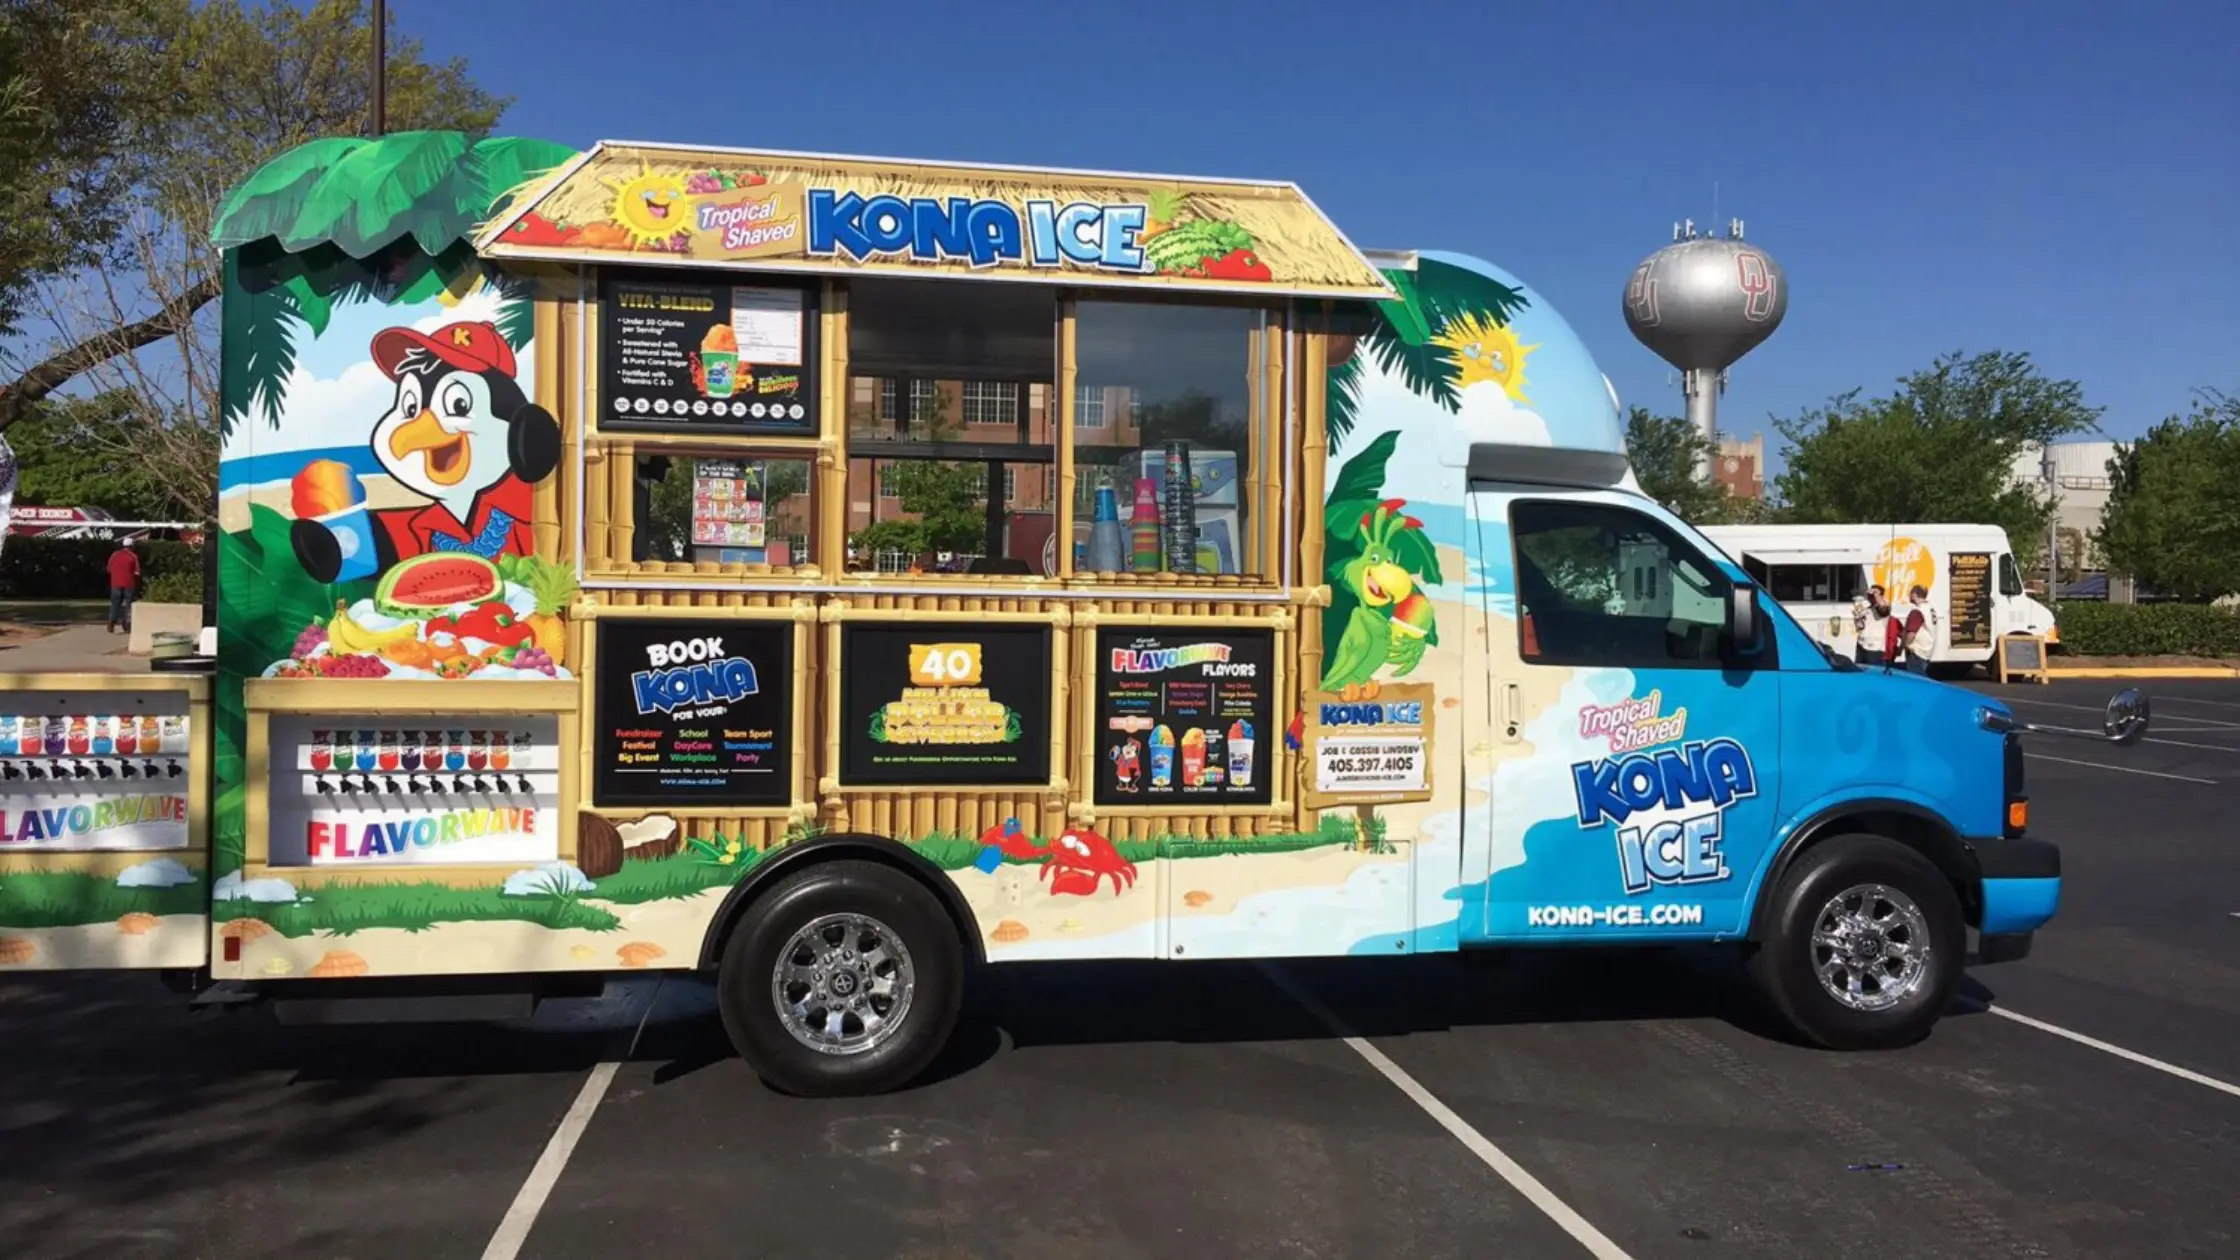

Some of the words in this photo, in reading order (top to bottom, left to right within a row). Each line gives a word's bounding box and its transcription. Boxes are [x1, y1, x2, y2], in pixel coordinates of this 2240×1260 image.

[700, 196, 778, 228] Tropical
[724, 217, 799, 249] Shaved
[808, 188, 1024, 268] KONA
[1026, 199, 1148, 269] ICE
[452, 326, 473, 347] K
[646, 636, 725, 667] BOOK
[920, 648, 972, 680] 40
[1202, 663, 1256, 676] FLAVORS
[631, 656, 759, 715] KONA
[672, 710, 693, 721] FOR
[1319, 703, 1384, 726] KONA
[1386, 702, 1421, 725] ICE
[1580, 691, 1660, 735] Tropical
[615, 729, 663, 738] Fundraiser
[678, 729, 709, 738] School
[722, 729, 747, 738] Team
[749, 729, 773, 740] Sport
[1612, 710, 1684, 751] Shaved
[622, 741, 656, 750] Festival
[674, 741, 712, 752] DayCare
[723, 741, 773, 750] Tournament
[618, 753, 634, 764] Big
[635, 753, 660, 762] Event
[669, 753, 717, 764] Workplace
[735, 753, 760, 764] Party
[1328, 757, 1413, 773] 405.397.4105
[1571, 737, 1756, 828] KONA
[307, 808, 535, 857] FLAVORWAVE
[1616, 811, 1722, 895] ICE
[1528, 905, 1702, 926] KONA-ICE.COM
